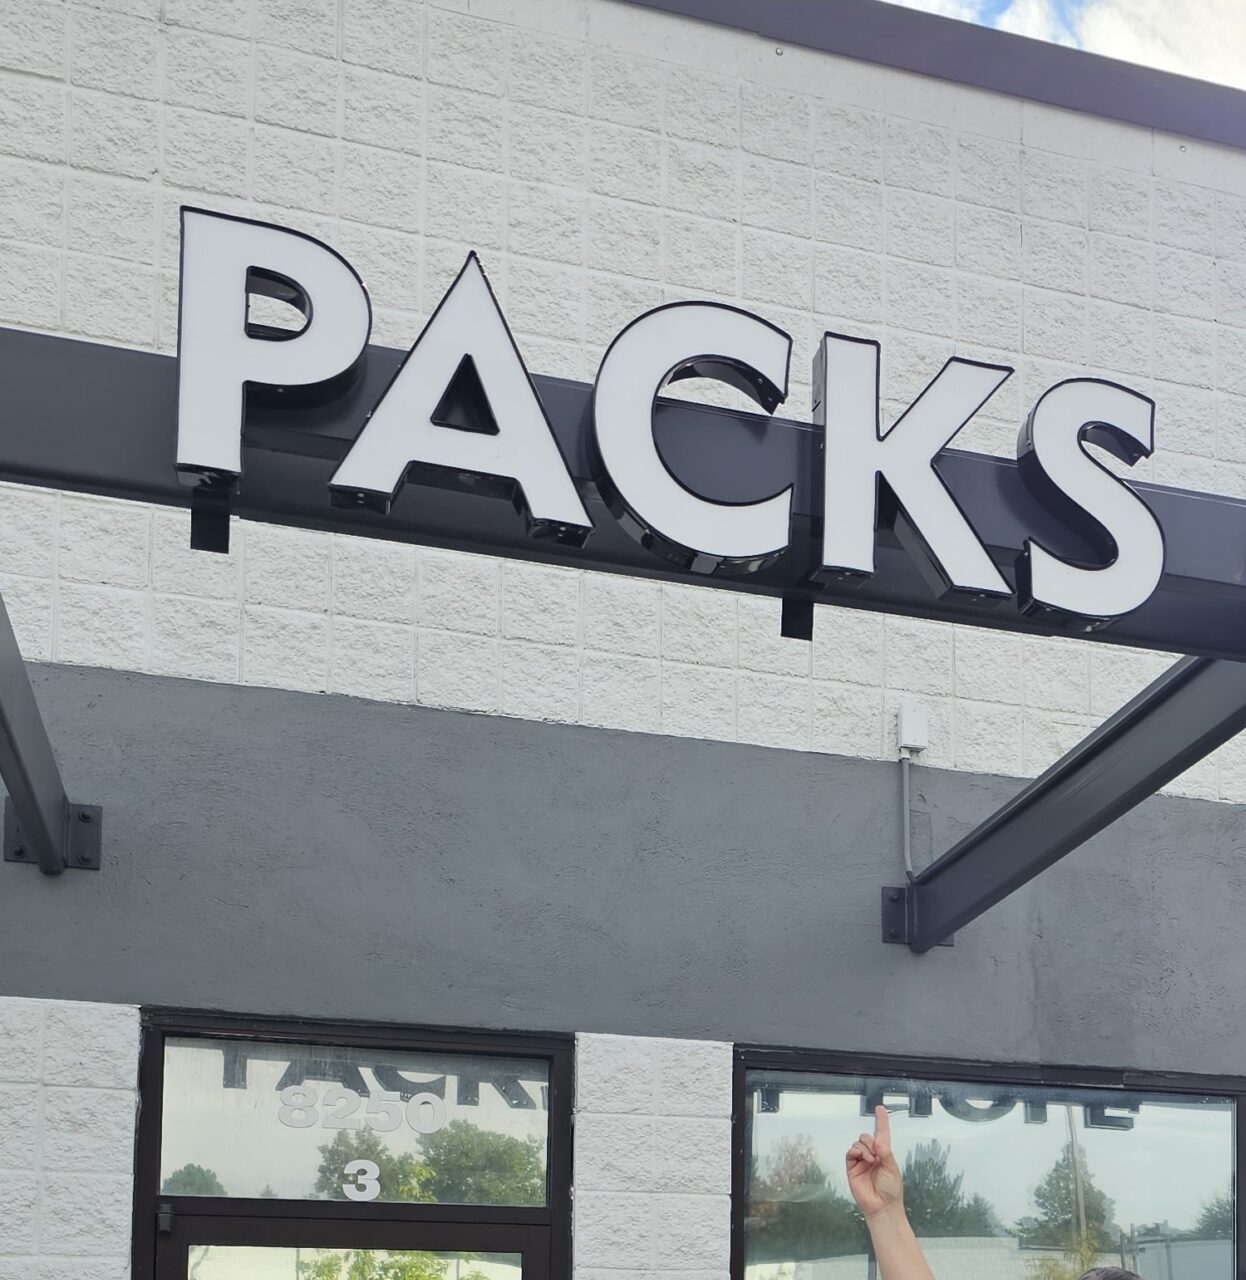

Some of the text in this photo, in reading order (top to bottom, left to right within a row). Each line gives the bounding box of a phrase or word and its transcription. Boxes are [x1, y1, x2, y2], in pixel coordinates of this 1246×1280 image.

[175, 205, 1165, 622] PACKS
[277, 1084, 447, 1134] 8250
[342, 1159, 381, 1201] 3
